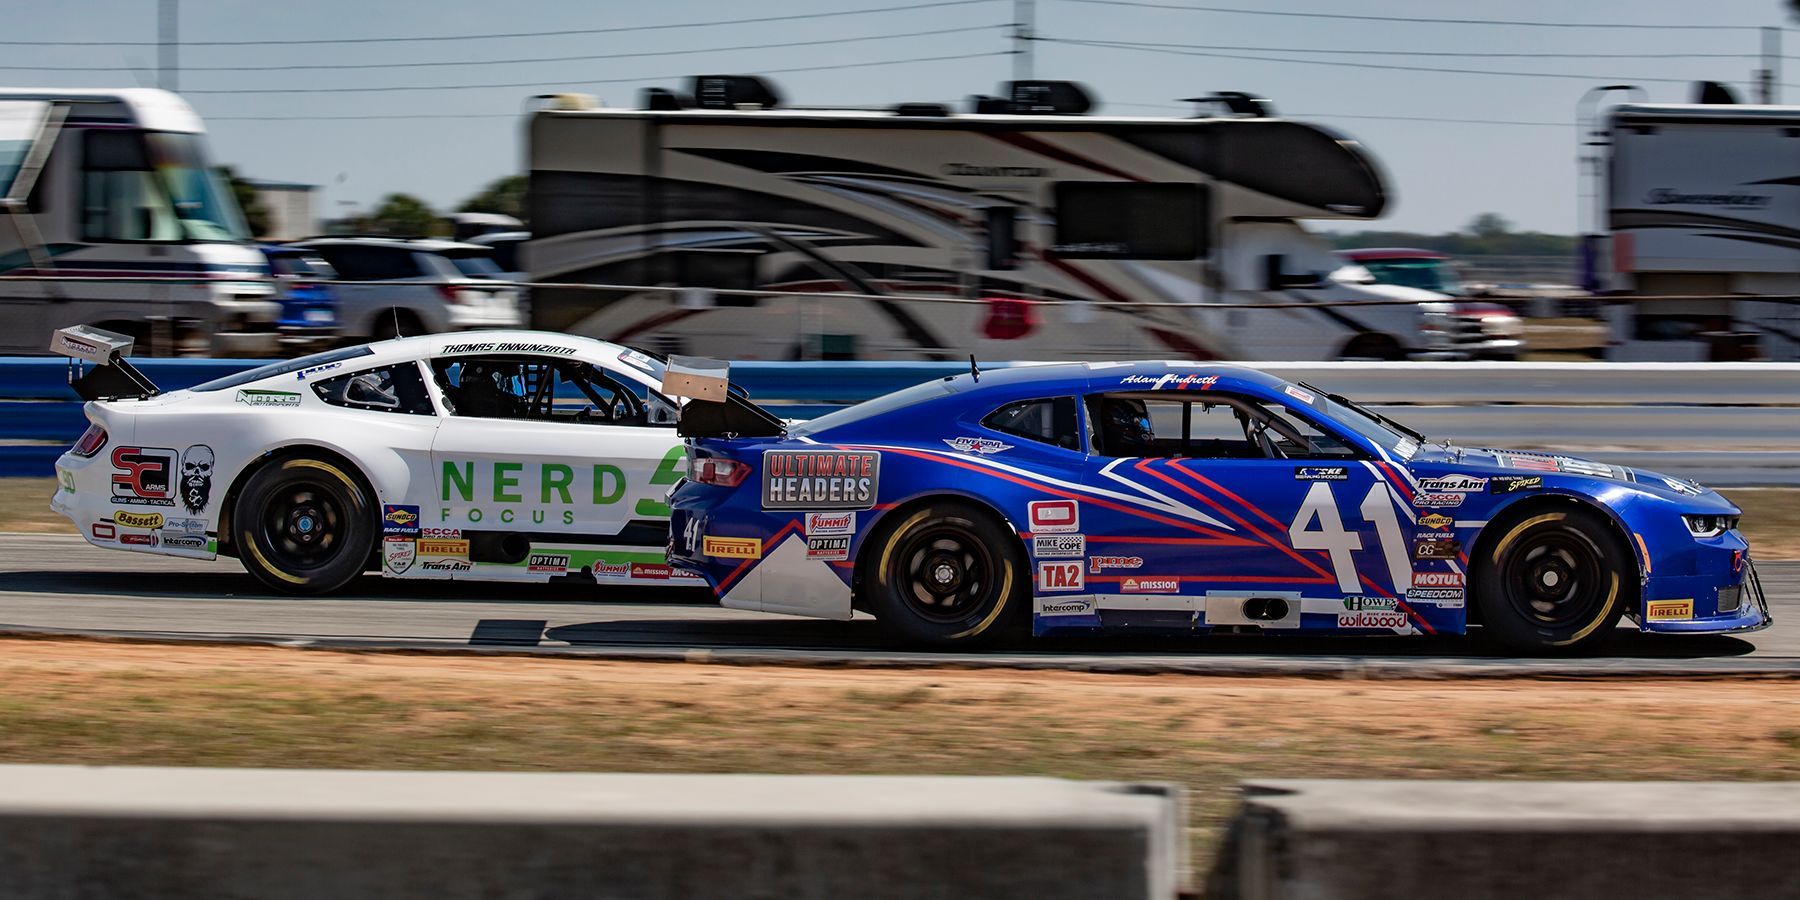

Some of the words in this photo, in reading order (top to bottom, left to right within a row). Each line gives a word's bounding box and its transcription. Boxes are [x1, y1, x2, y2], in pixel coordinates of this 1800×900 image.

[443, 343, 495, 353] THOMAS
[496, 342, 577, 354] ANNUNZIATA
[1120, 374, 1159, 385] Adam
[1159, 374, 1220, 385] Andretti
[770, 454, 873, 477] ULTIMATE
[442, 461, 626, 505] NERD
[1418, 479, 1458, 489] Trans
[1459, 479, 1484, 489] Am
[1508, 478, 1541, 492] SPIKED
[769, 477, 870, 502] HEADERS
[118, 513, 160, 527] Bassett
[386, 512, 417, 521] SUNOCO
[441, 508, 574, 525] FOCUS
[1418, 517, 1451, 525] SUNOCO
[423, 528, 461, 536] SCCA
[684, 517, 700, 552] 41
[1288, 481, 1412, 595] 41
[164, 537, 202, 548] Intercomp
[419, 542, 467, 554] PIRELLI
[706, 541, 756, 555] PIRELLI
[810, 539, 846, 550] OPTIMA
[1418, 544, 1434, 555] CG
[422, 562, 451, 570] Trans
[451, 562, 471, 570] Am
[531, 556, 567, 566] OPTIMA
[1043, 565, 1079, 587] TA2
[1414, 574, 1460, 585] MOTUL
[1407, 590, 1462, 598] SPEEDCOM
[1042, 604, 1085, 613] Intercomp
[1349, 596, 1391, 611] HOWE
[1650, 603, 1689, 617] PIRELLI
[1339, 613, 1407, 628] wilwood
